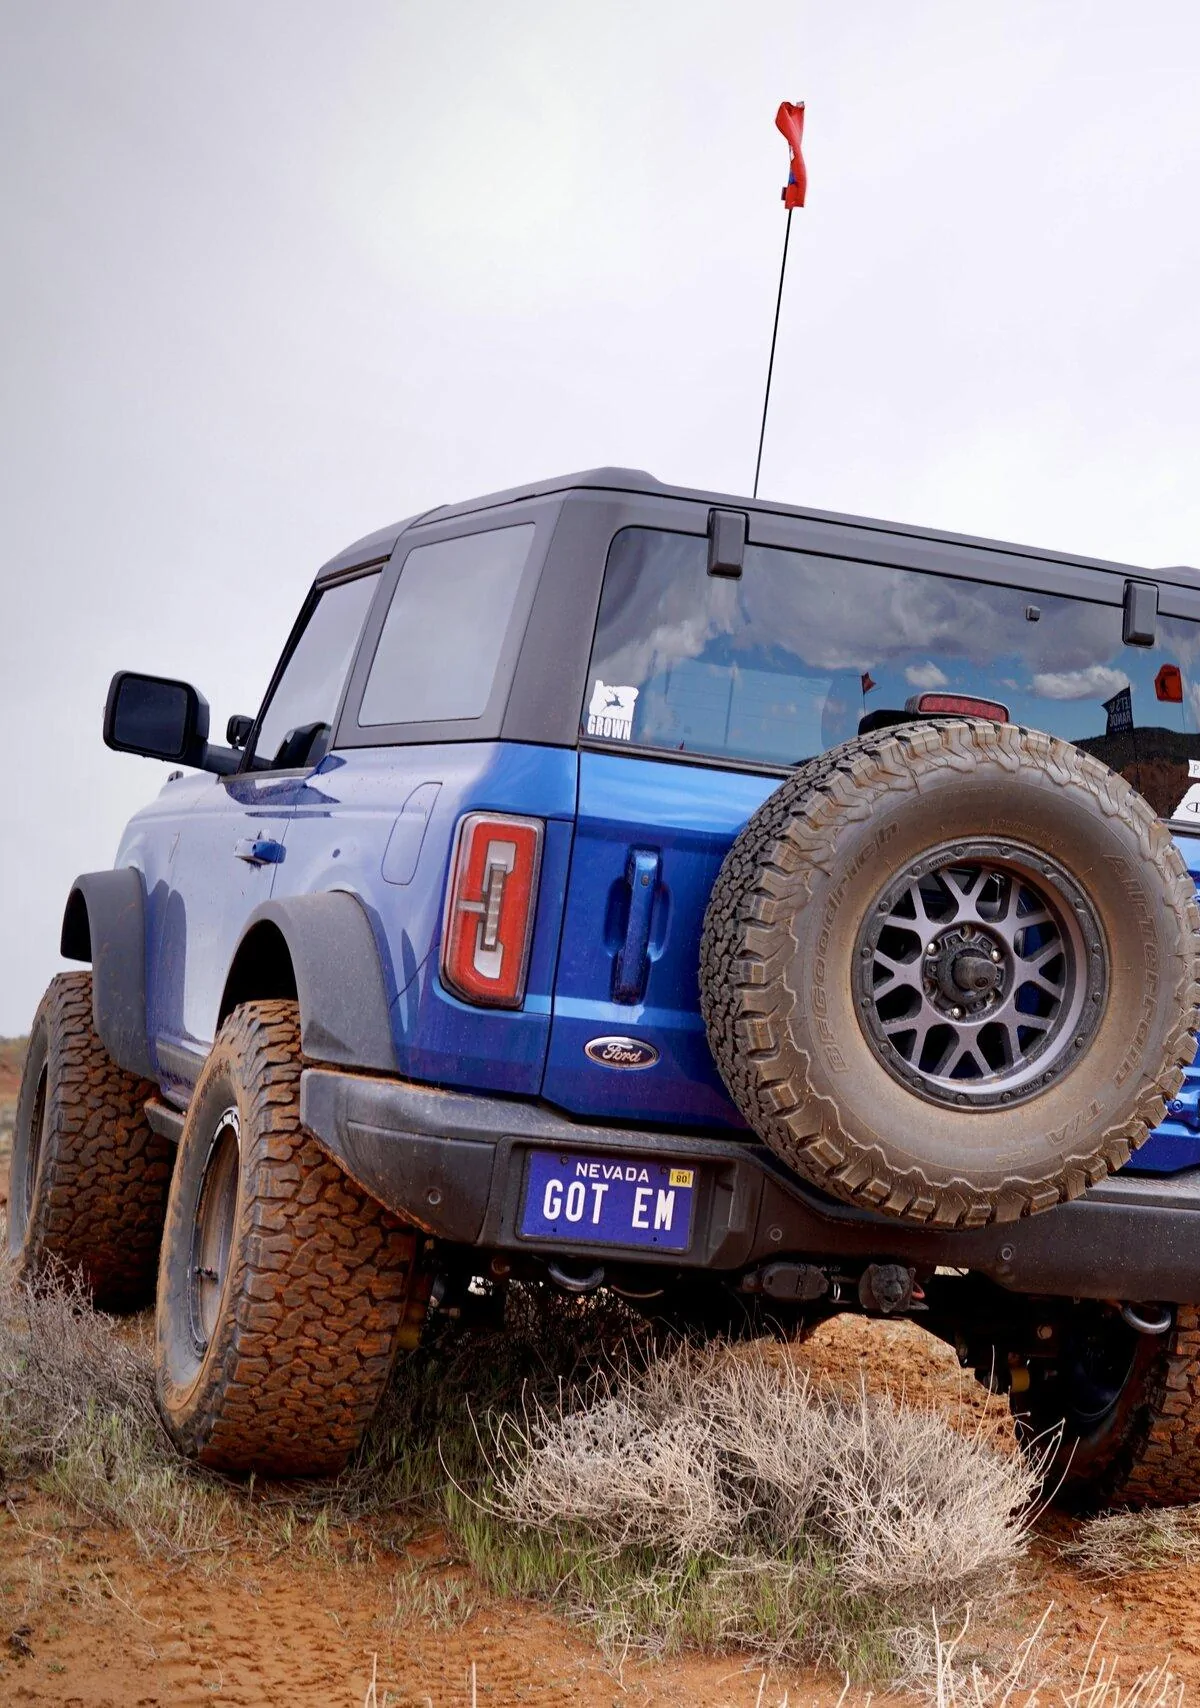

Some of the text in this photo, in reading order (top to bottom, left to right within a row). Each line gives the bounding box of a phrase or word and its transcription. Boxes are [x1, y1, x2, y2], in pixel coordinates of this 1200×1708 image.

[587, 715, 632, 740] GROWN
[602, 1042, 642, 1062] Ford
[575, 1162, 649, 1183] NEVADA
[543, 1179, 675, 1231] GOT EM
